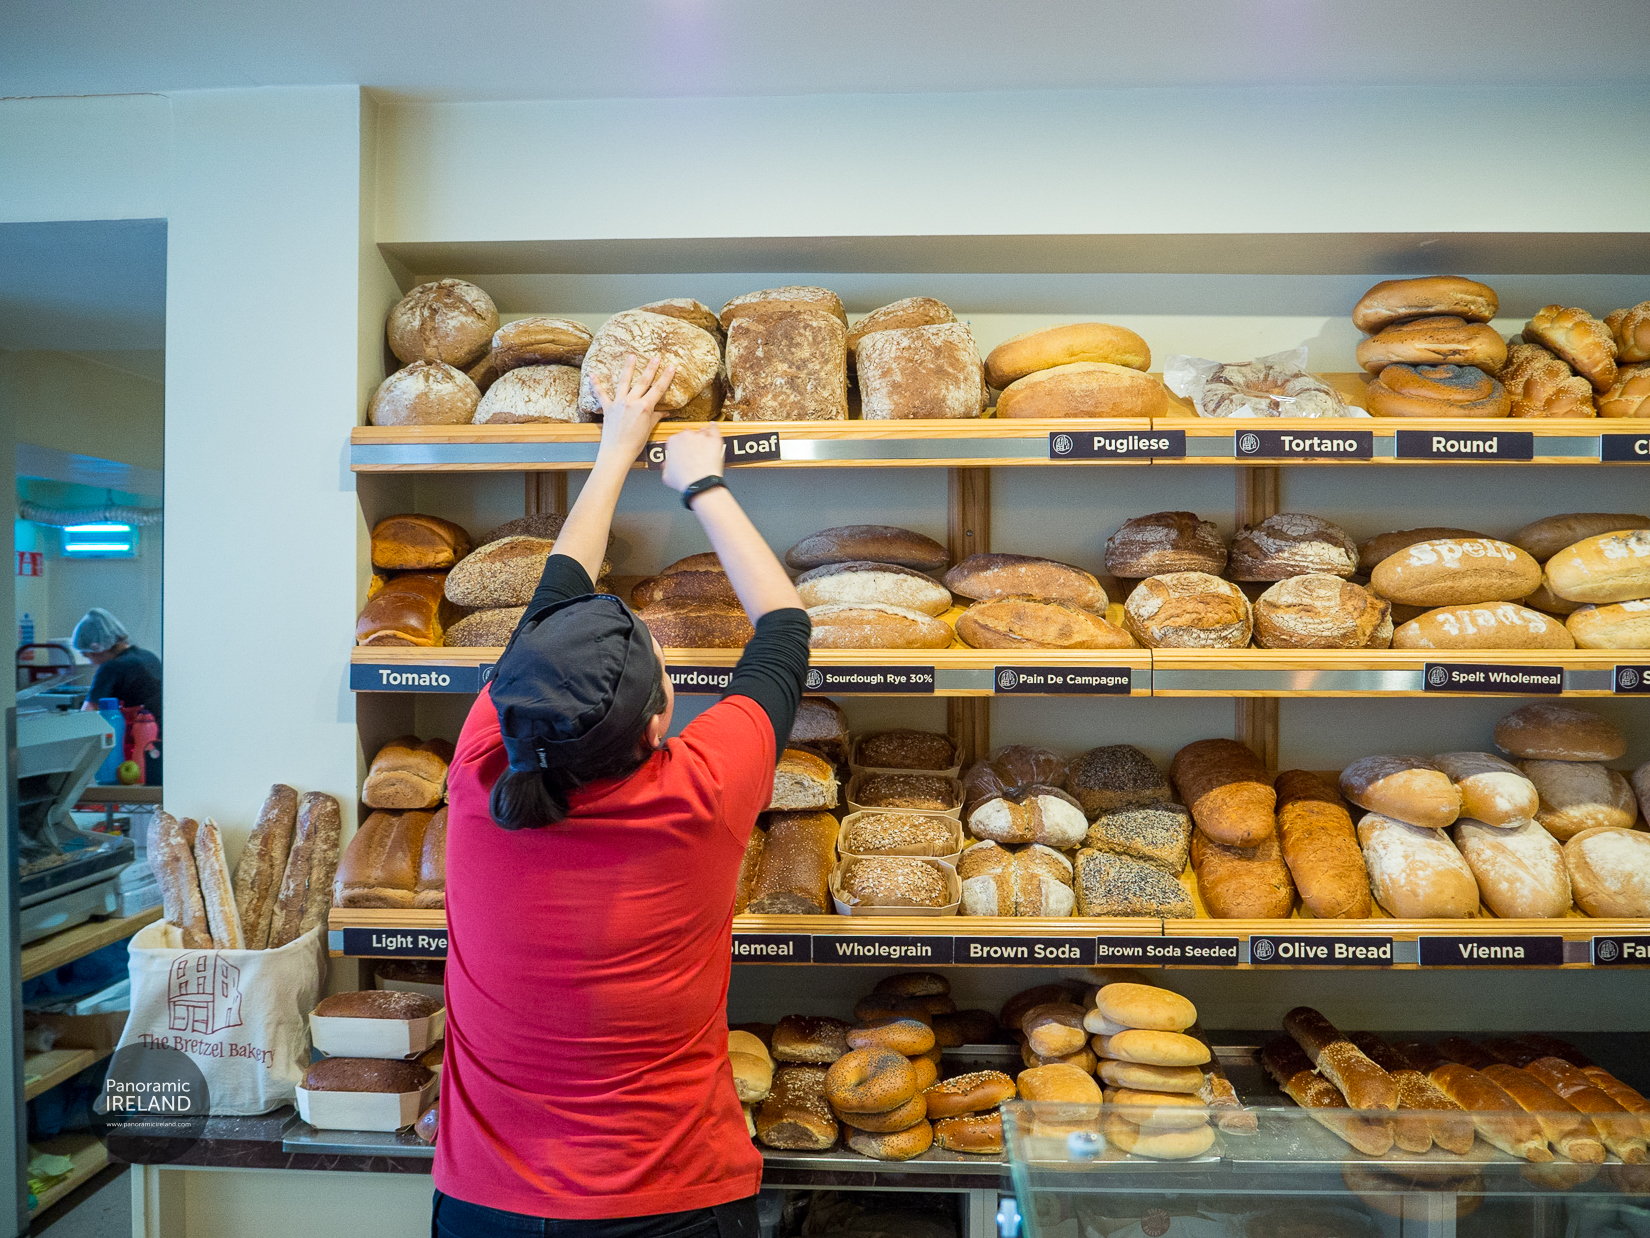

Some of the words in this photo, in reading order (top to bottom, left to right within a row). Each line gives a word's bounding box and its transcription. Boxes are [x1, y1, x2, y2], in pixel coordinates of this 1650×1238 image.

[733, 435, 778, 455] Loaf
[1093, 436, 1170, 454] Pugliese
[1281, 436, 1358, 452] Tortano
[1432, 436, 1498, 454] Round
[1634, 439, 1650, 455] C
[378, 669, 451, 687] Tomato
[671, 671, 734, 688] urdoug
[826, 672, 884, 687] Sourdough
[887, 673, 907, 687] Rye
[908, 673, 933, 685] 30%
[1019, 673, 1045, 686] Pain
[1047, 674, 1063, 686] De
[1066, 674, 1130, 688] Campagne
[1451, 670, 1486, 686] Spelt
[1488, 671, 1561, 686] Wholemeal
[372, 934, 413, 950] Light
[418, 935, 447, 951] Rye
[731, 940, 794, 956] lemeal
[1099, 944, 1144, 957] Brown
[1146, 945, 1181, 957] Soda
[1184, 945, 1237, 957] Seeded
[1278, 942, 1329, 959] Olive
[1334, 943, 1391, 959] Bread
[835, 942, 932, 960] Wholegrain
[969, 943, 1028, 958] Brown
[1033, 943, 1081, 959] Soda
[1458, 943, 1525, 959] Vienna
[138, 1032, 170, 1051] The
[172, 1035, 224, 1058] Bretzel
[229, 1043, 277, 1068] Bakery
